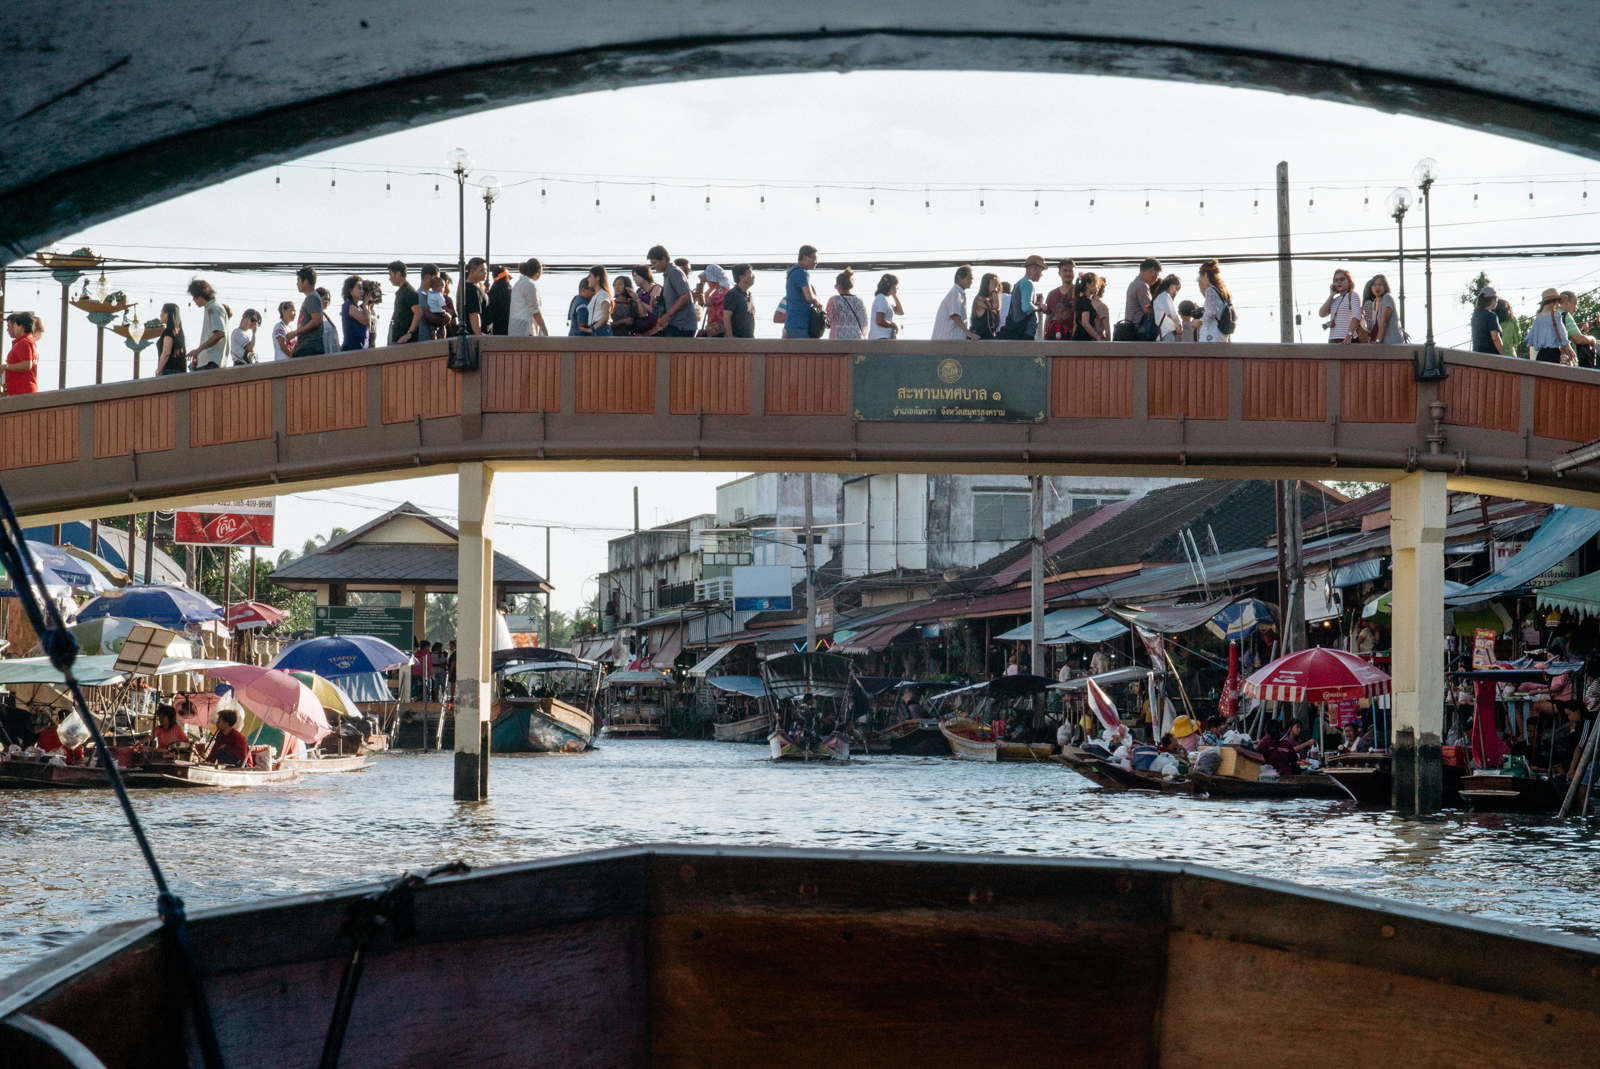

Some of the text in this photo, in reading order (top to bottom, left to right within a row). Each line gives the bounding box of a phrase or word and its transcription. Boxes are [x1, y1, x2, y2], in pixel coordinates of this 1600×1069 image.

[897, 386, 987, 400] สะพานเทศบาล
[941, 405, 1006, 418] จังหวัดสมุทรสงคราม
[327, 655, 358, 663] TEAPOT
[1322, 691, 1348, 700] Carnation
